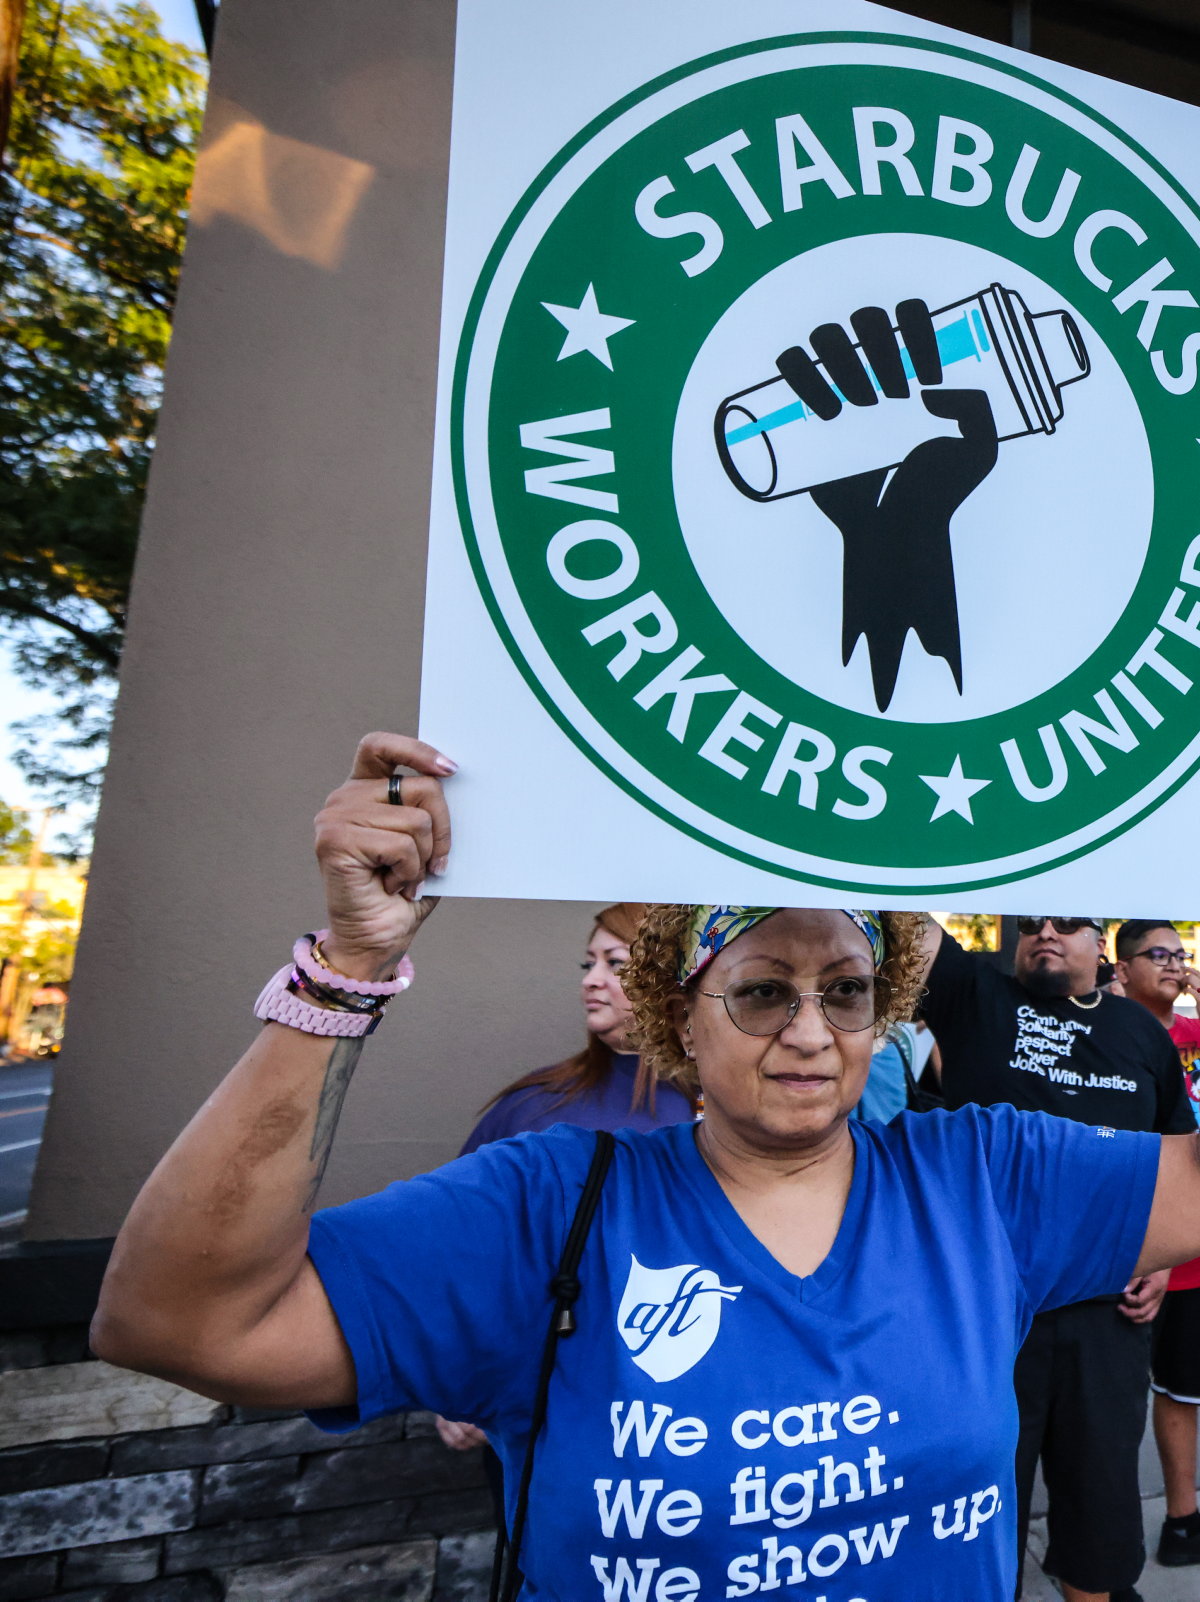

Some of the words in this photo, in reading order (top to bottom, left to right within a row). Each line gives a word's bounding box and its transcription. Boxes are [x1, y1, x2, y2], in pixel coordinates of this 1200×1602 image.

[519, 407, 894, 821] WORKERS
[1009, 1055, 1046, 1076] Jobs
[1048, 1067, 1082, 1086] With
[1084, 1073, 1137, 1092] Justice
[610, 1400, 708, 1458] We
[732, 1394, 899, 1450] care.
[594, 1479, 702, 1538] We
[730, 1446, 904, 1529] fight.
[590, 1554, 701, 1602] We
[726, 1515, 910, 1598] show
